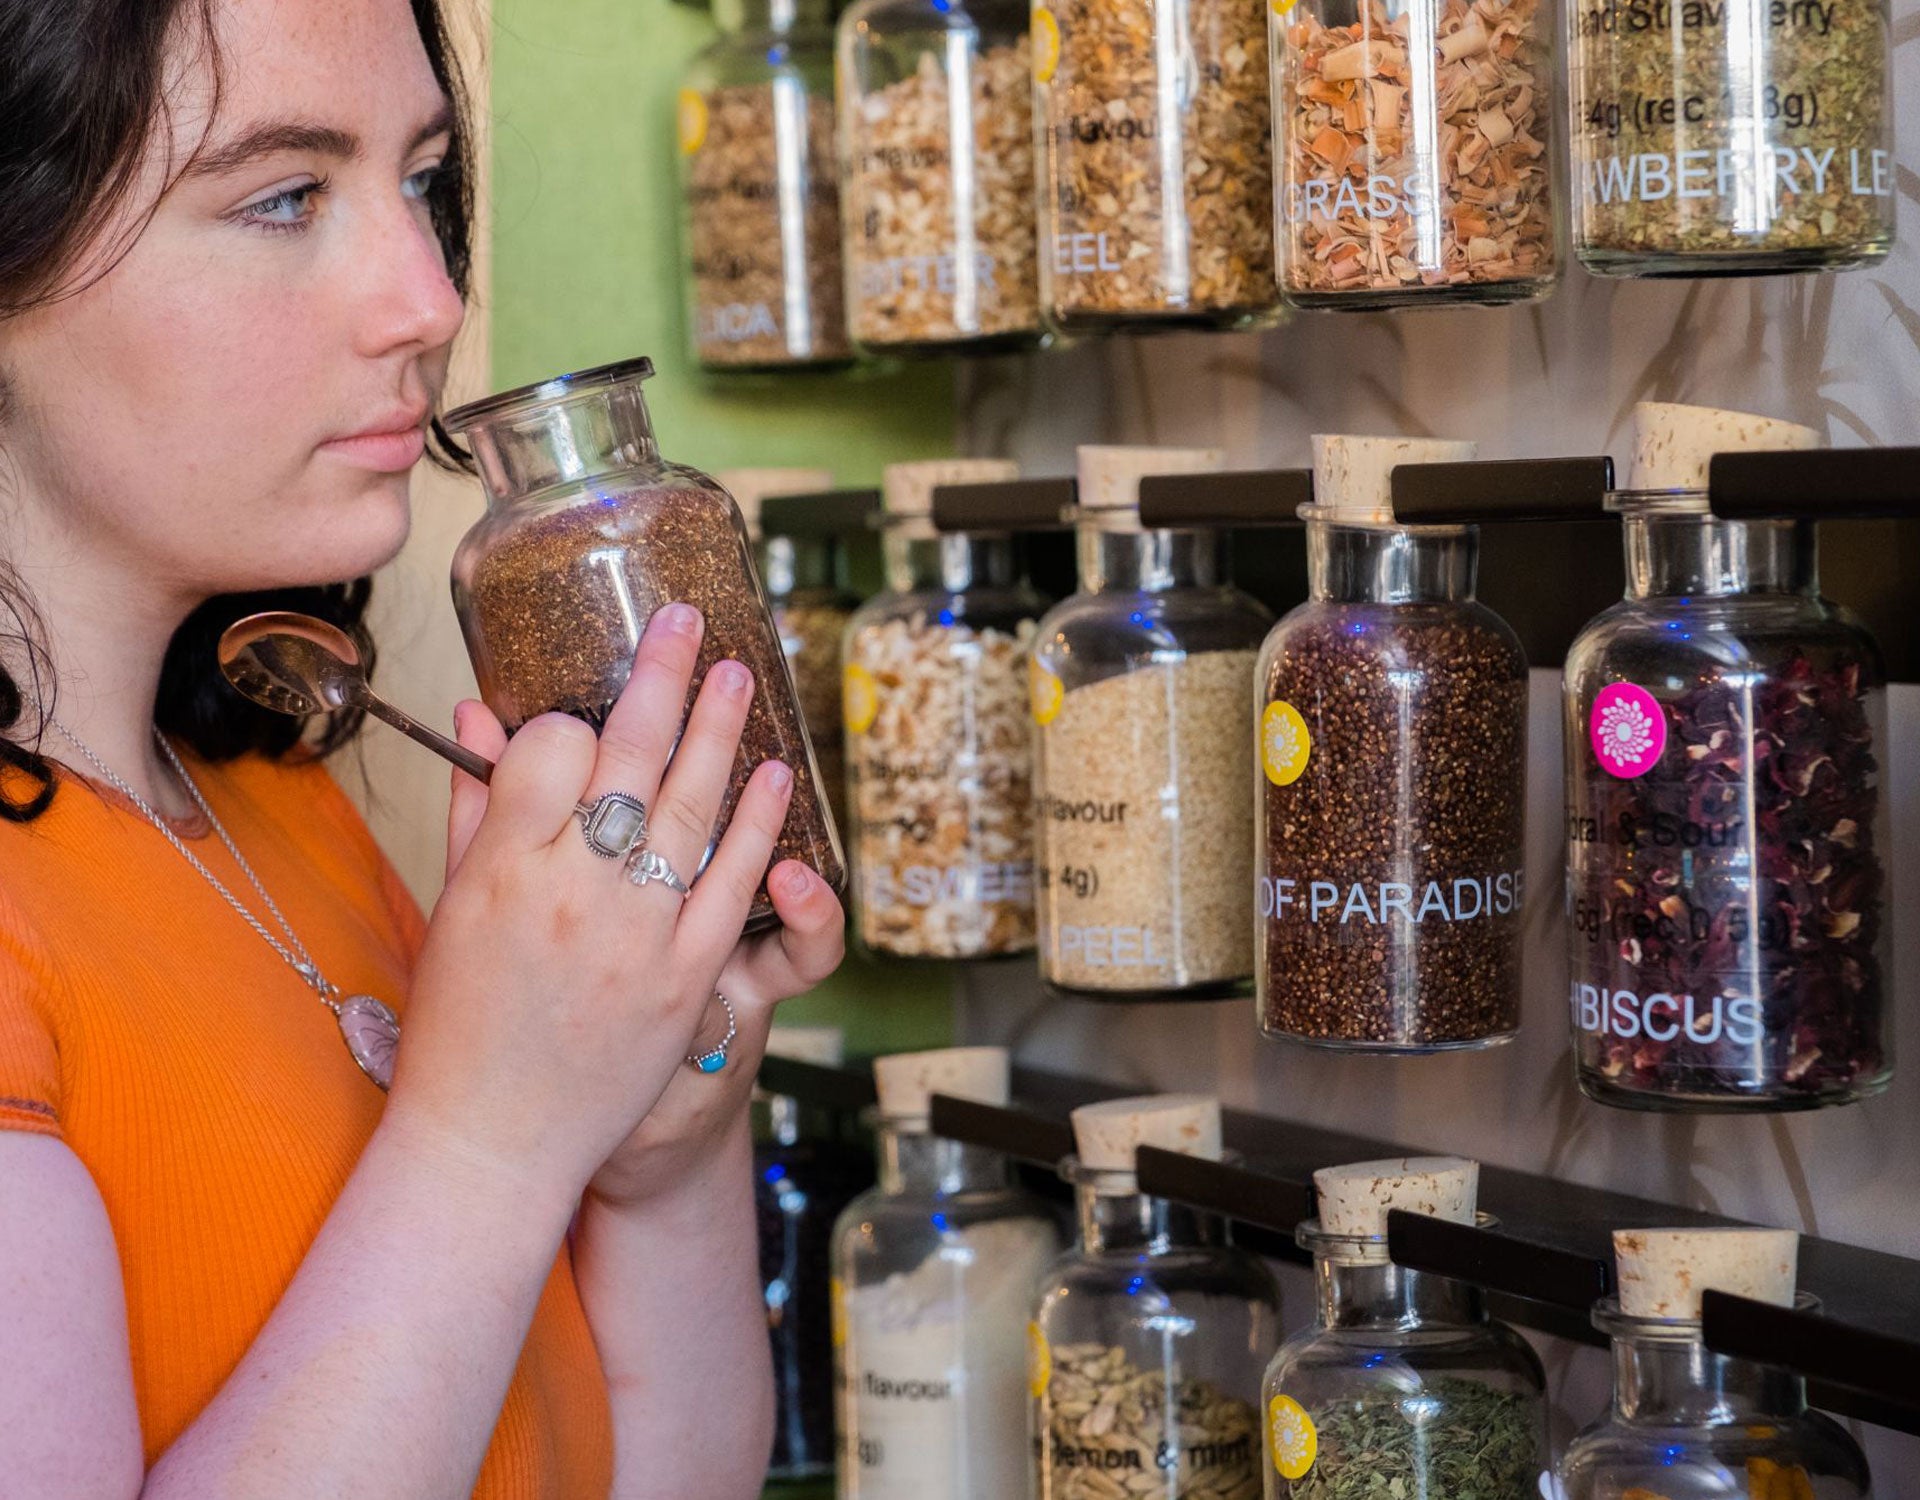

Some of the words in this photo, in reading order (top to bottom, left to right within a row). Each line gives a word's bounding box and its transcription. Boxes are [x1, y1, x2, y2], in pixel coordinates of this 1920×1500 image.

[1283, 174, 1433, 223] GRASS
[1259, 876, 1296, 919] OF
[1310, 870, 1526, 925] PARADISE
[1060, 924, 1169, 968] PEEL
